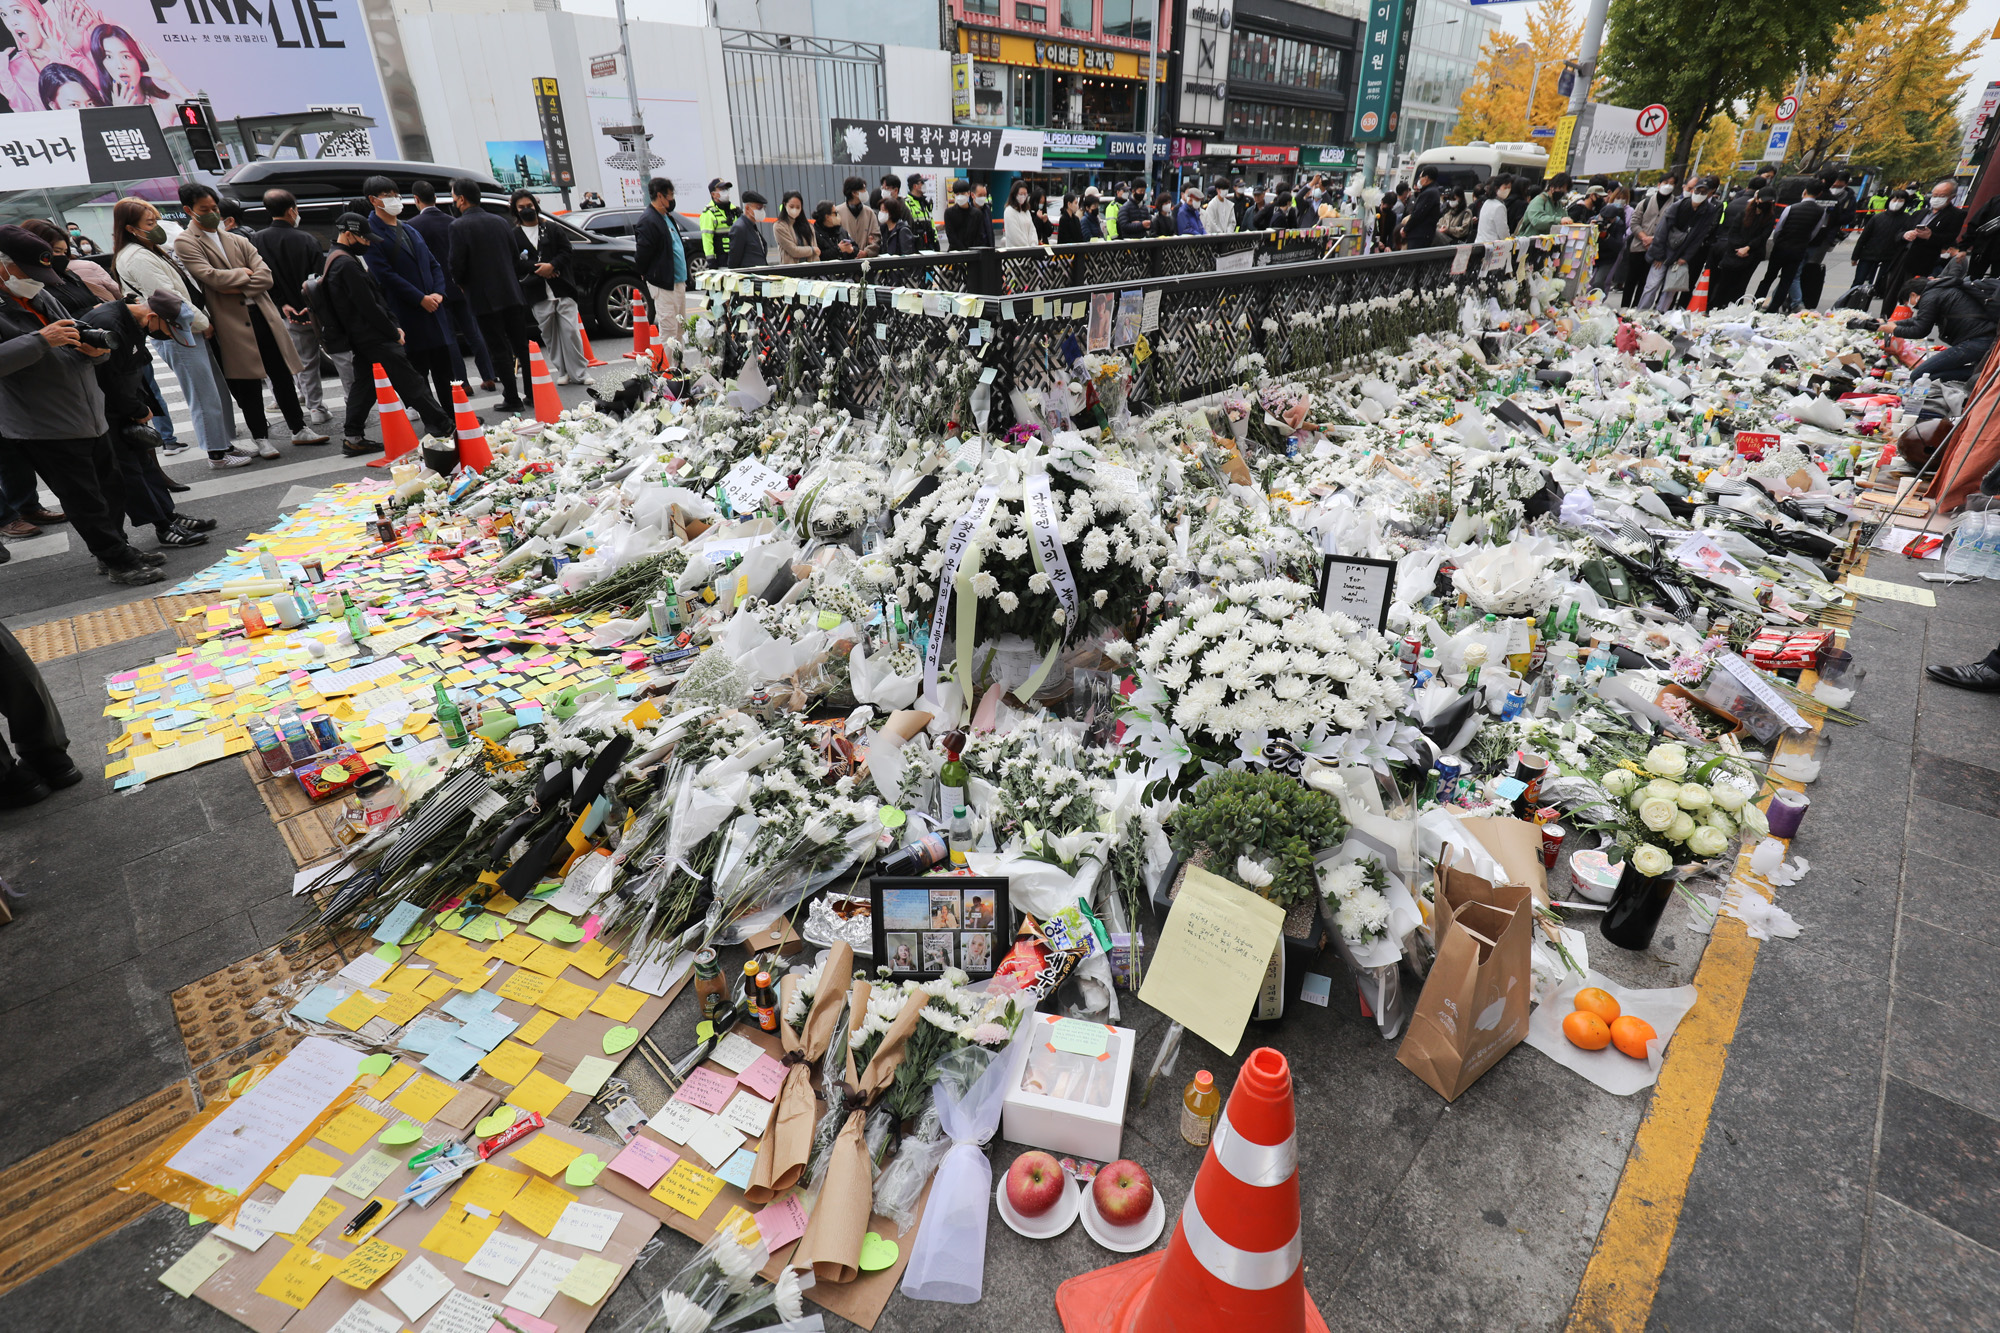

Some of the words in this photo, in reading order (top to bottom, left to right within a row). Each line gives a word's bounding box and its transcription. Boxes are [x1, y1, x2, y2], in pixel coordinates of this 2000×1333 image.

[163, 34, 198, 43] 디즈니+
[202, 34, 211, 43] 첫
[214, 34, 231, 43] 연애
[235, 34, 269, 43] 리얼리티
[1371, 4, 1390, 71] 이태원
[1047, 46, 1080, 66] 이바돔
[1084, 49, 1116, 70] 감자탕
[549, 98, 557, 108] 4
[1780, 102, 1793, 116] 50
[1362, 117, 1376, 126] 630
[100, 128, 146, 147] 더불어
[552, 115, 564, 149] 이태원
[877, 124, 915, 144] 이태원
[920, 127, 944, 145] 참사
[948, 130, 992, 147] 희생자의
[1072, 134, 1097, 146] KEBAB
[3, 136, 76, 167] 빕니다
[107, 144, 151, 163] 민주당
[899, 147, 935, 164] 명복을
[940, 148, 973, 166] 빕니다
[1013, 145, 1039, 157] 국민의힘
[1110, 142, 1135, 154] EDIYA
[1136, 143, 1167, 154] COFEE
[949, 520, 976, 554] 찾으러
[944, 558, 955, 571] 온
[1041, 535, 1058, 562] 너의
[1052, 569, 1067, 582] 손
[1346, 565, 1368, 575] pray
[940, 576, 951, 600] 나의
[929, 605, 946, 666] 친구들이여
